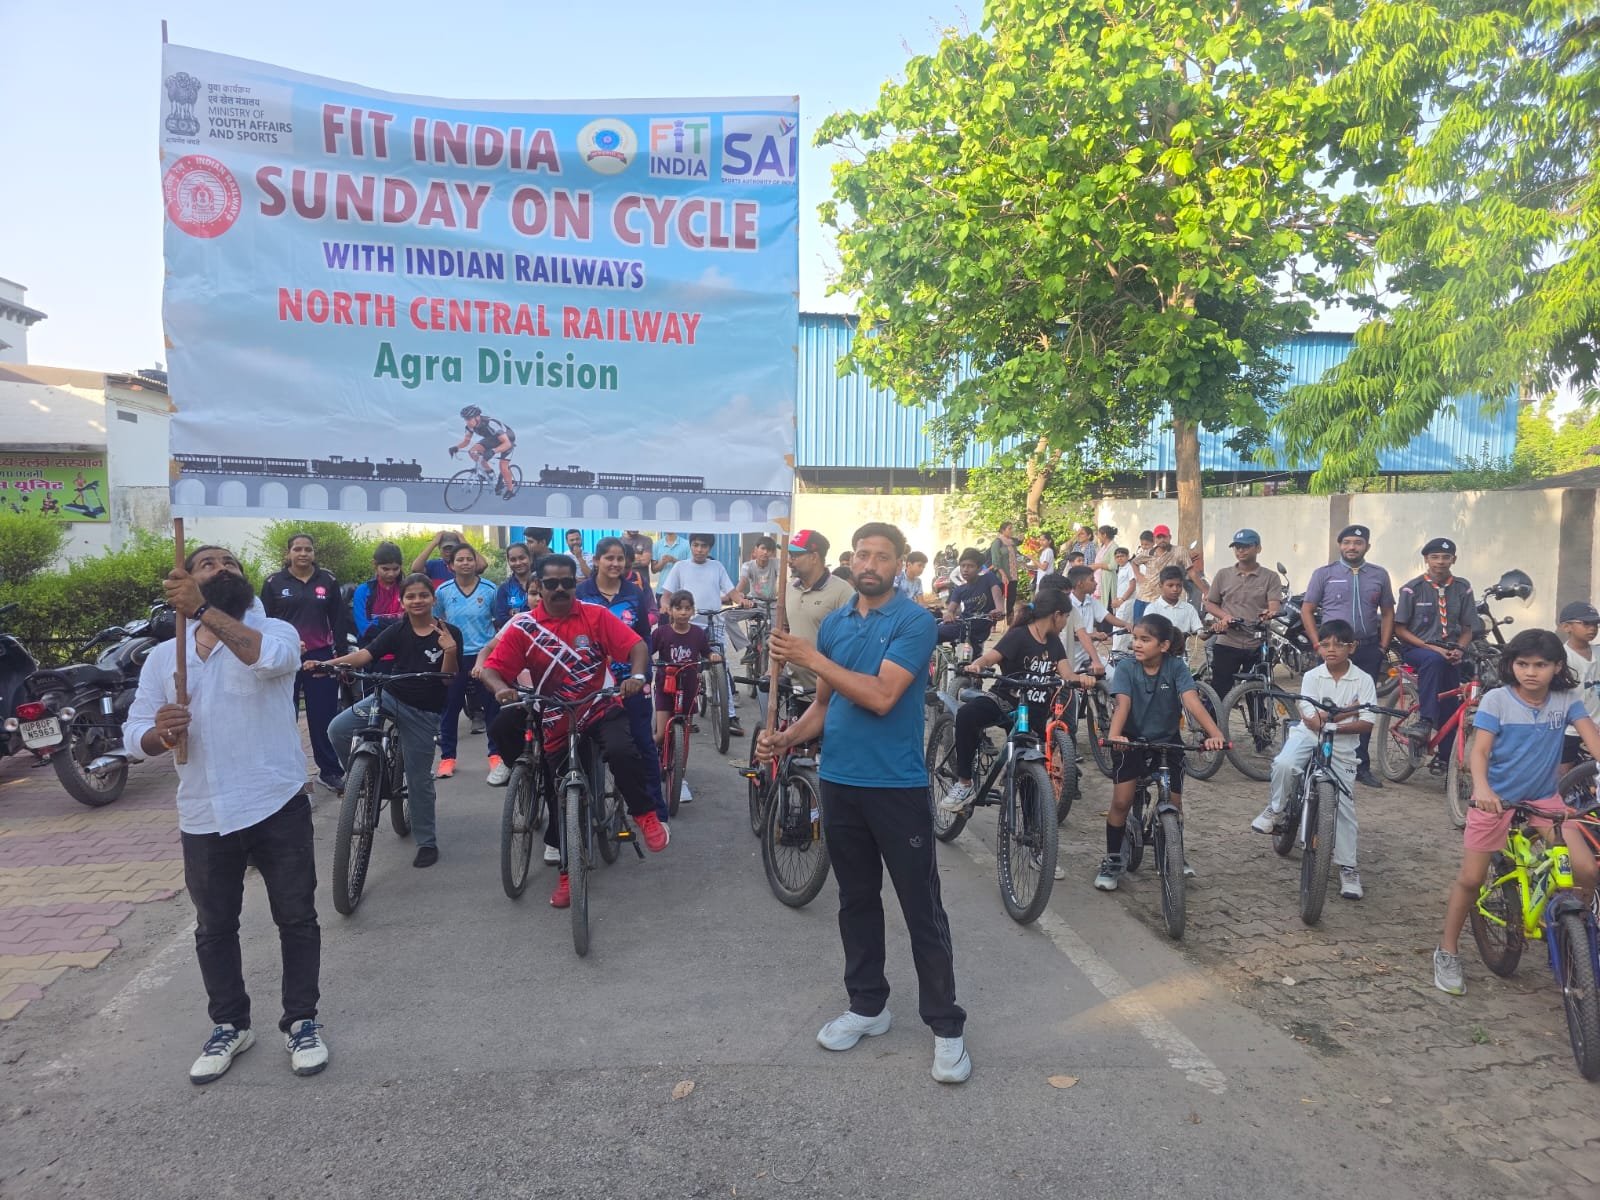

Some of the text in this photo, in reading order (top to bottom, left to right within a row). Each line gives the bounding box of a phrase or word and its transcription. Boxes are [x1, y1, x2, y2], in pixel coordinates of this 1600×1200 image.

[208, 107, 264, 119] MINISTRY OF
[208, 117, 293, 133] YOUTH AFFAIRS
[209, 128, 278, 143] AND SPORTS
[323, 103, 560, 173] FIT INDIA
[722, 133, 797, 177] SAI
[195, 156, 241, 221] INDIAN RAILWAYS
[650, 156, 707, 177] INDIA
[256, 166, 757, 250] SUNDAY ON CYCLE
[323, 242, 645, 289] WITH INDIAN RAILWAYS
[278, 287, 702, 345] NORTH CENTRAL RAILWAY
[373, 341, 619, 391] Agra Division
